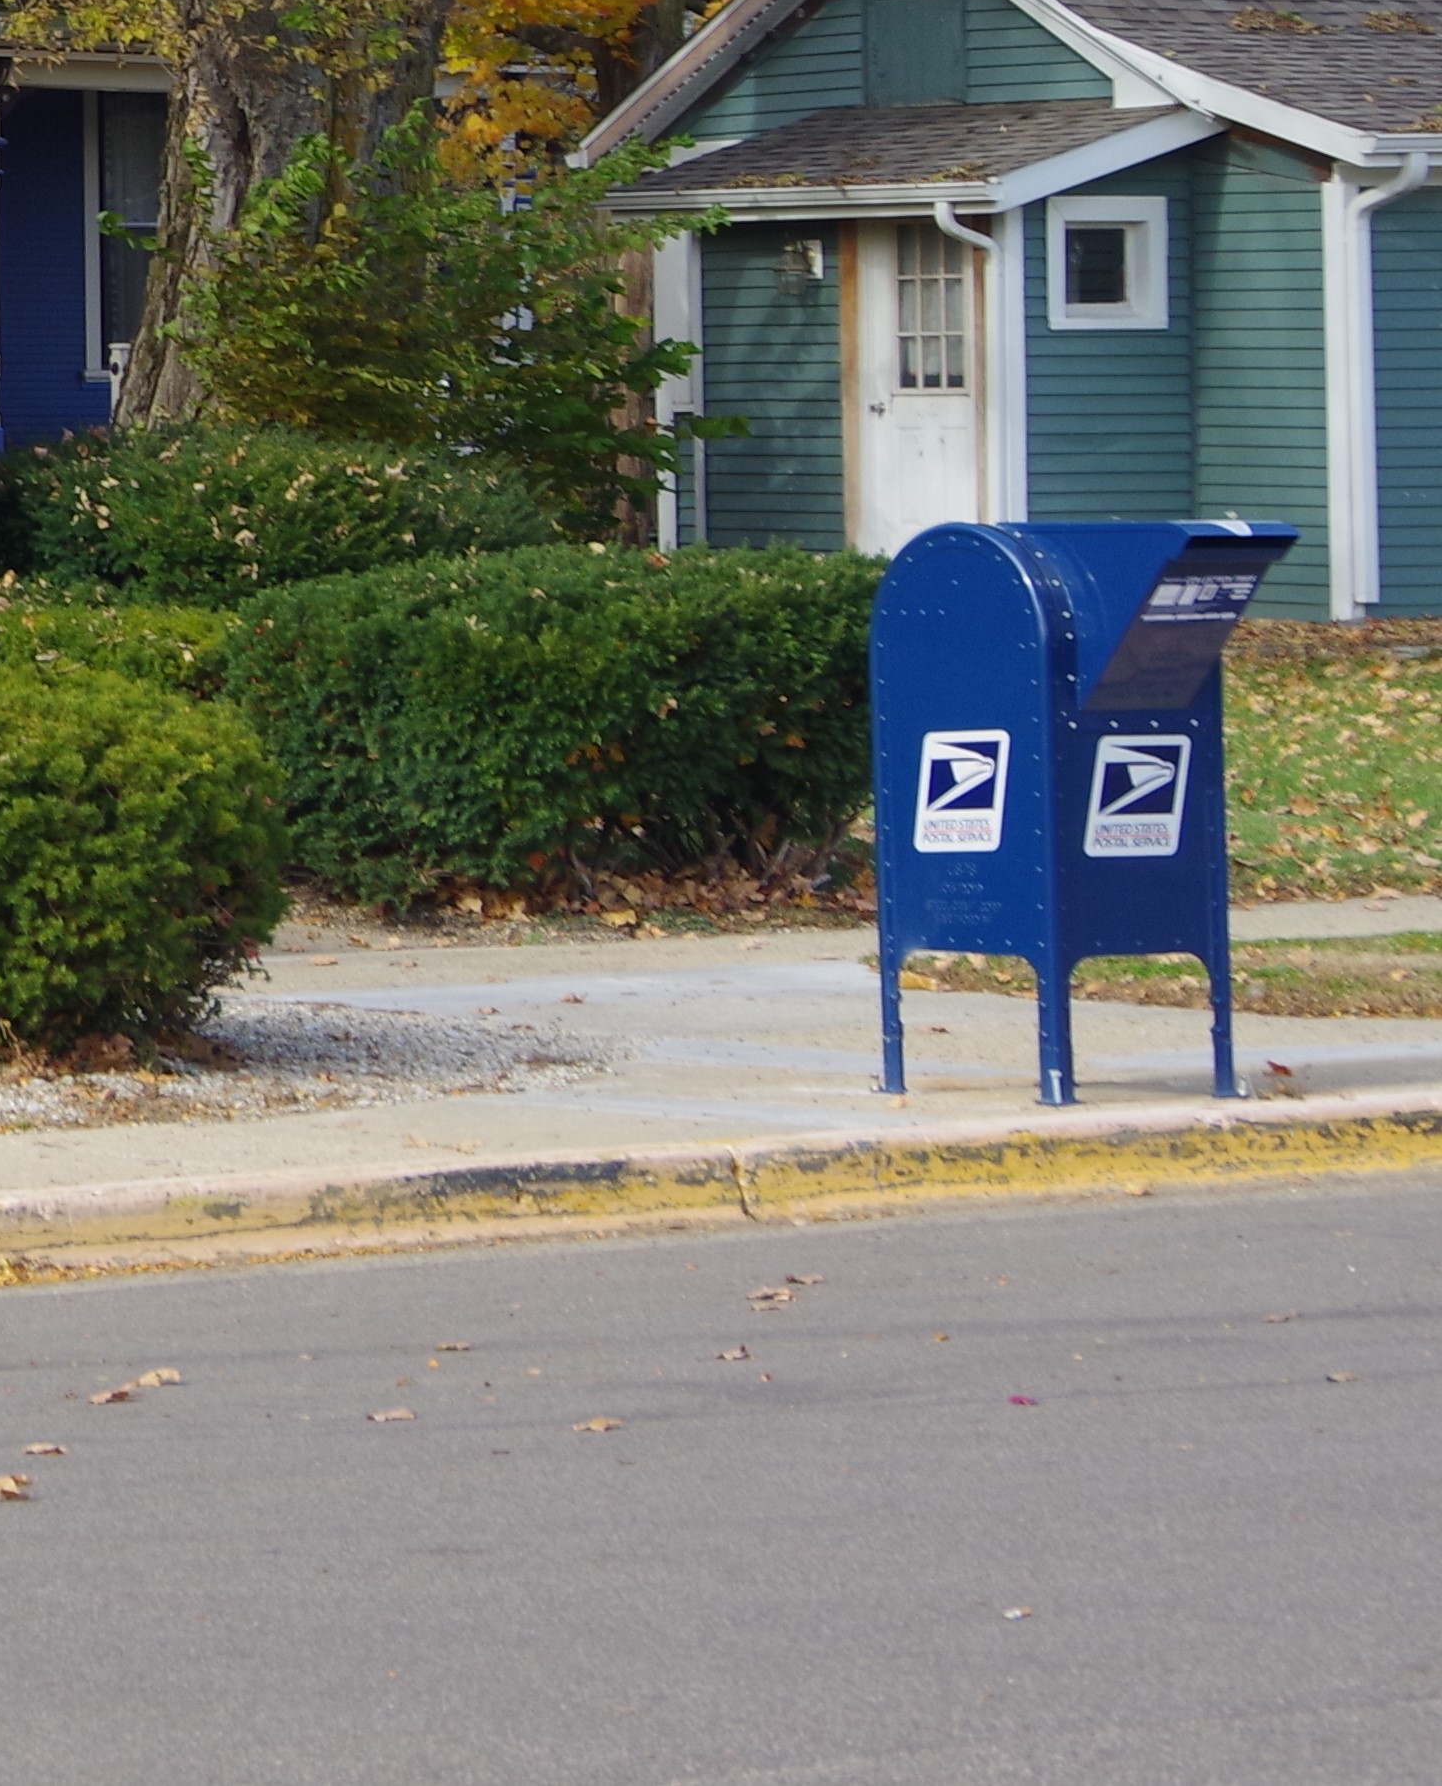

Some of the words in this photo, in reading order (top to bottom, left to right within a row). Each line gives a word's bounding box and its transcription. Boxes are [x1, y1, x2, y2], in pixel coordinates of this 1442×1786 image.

[923, 819, 957, 830] UNITED
[959, 819, 991, 829] STATES
[1095, 824, 1132, 835] UNITED
[1135, 823, 1169, 833] STATES
[922, 833, 955, 844] POSTAL
[958, 832, 994, 843] SERVICE
[1094, 838, 1130, 848] POSTAL
[1133, 837, 1172, 847] SERVICE
